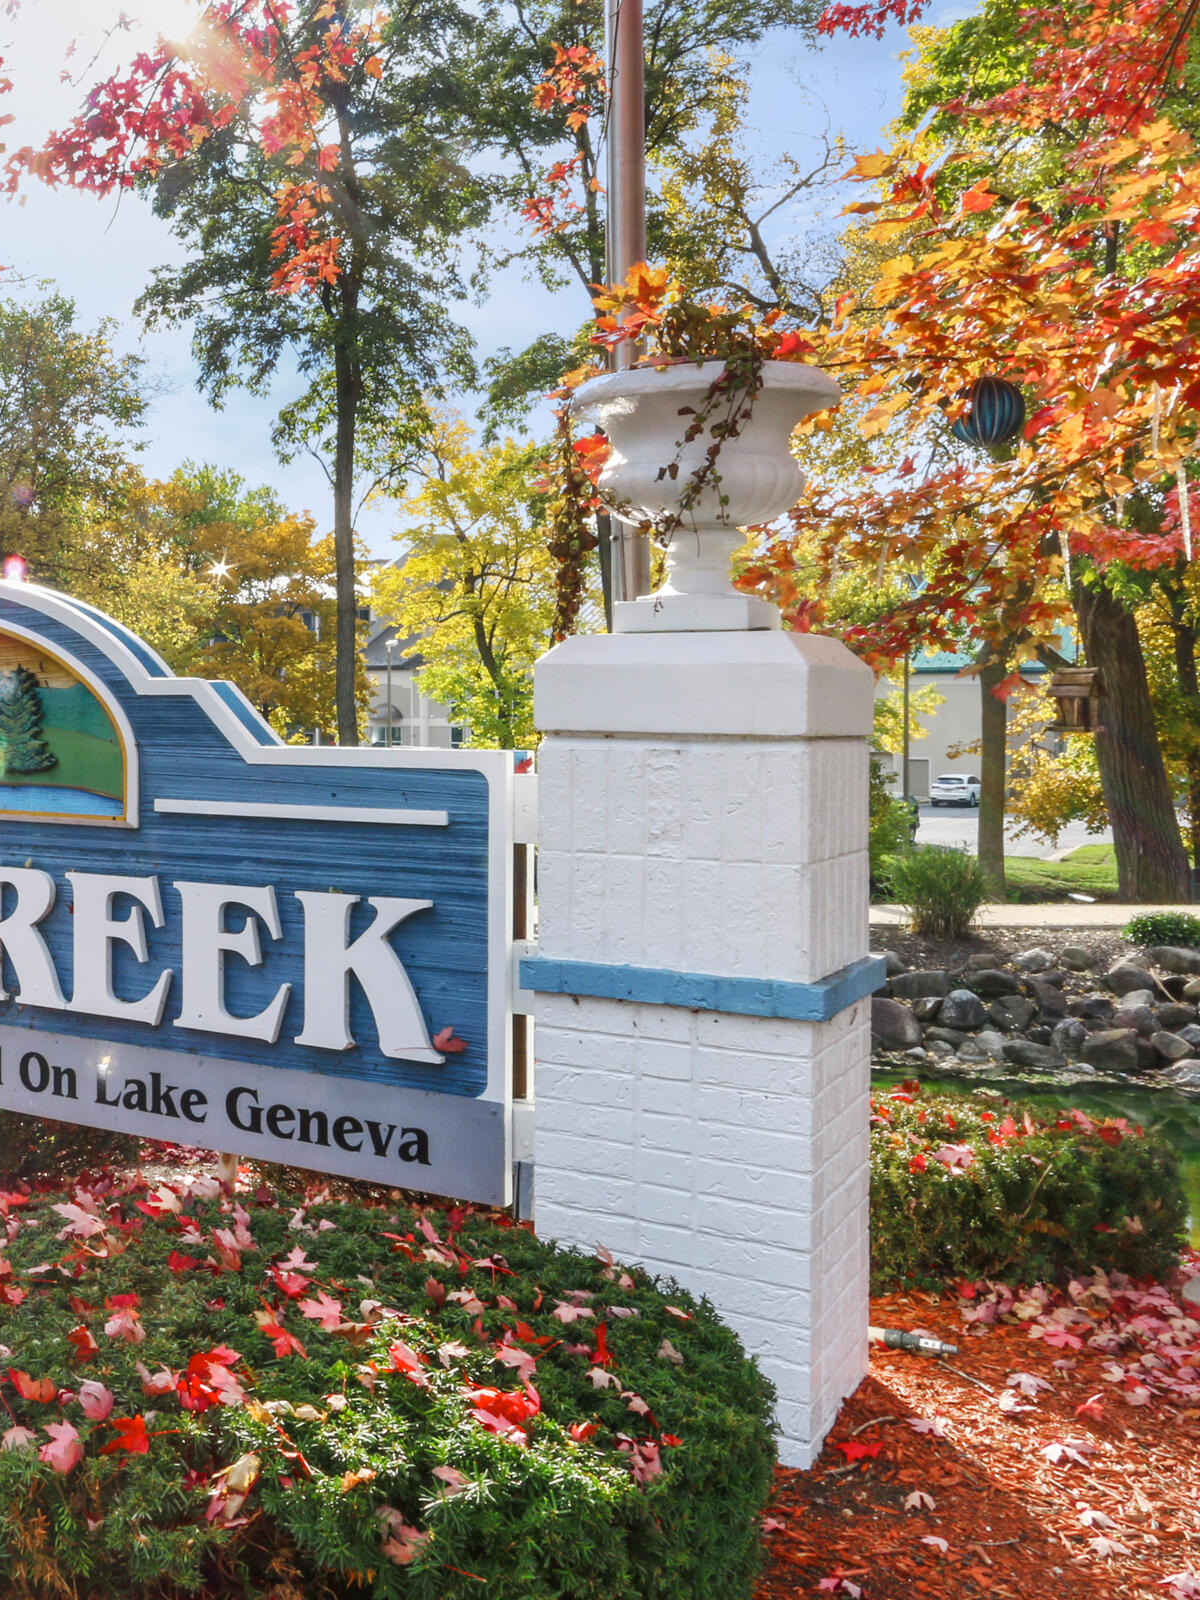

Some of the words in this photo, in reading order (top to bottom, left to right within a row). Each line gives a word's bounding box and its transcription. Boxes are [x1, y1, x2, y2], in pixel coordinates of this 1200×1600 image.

[19, 1051, 79, 1100] On
[94, 1064, 208, 1123] Lake
[225, 1086, 433, 1166] Geneva
